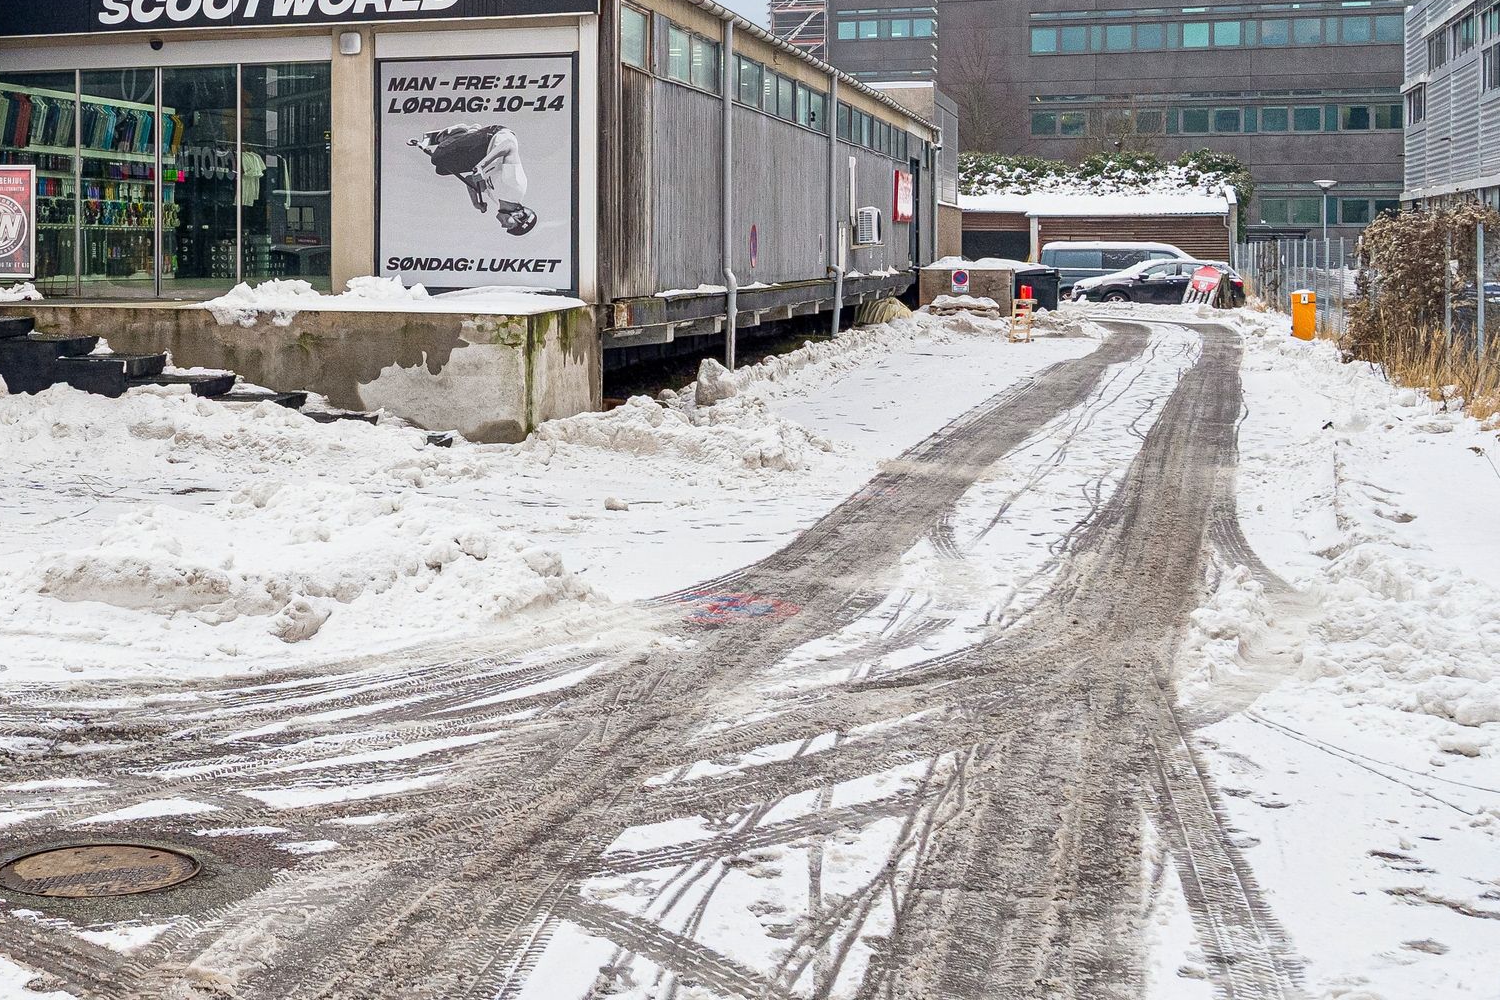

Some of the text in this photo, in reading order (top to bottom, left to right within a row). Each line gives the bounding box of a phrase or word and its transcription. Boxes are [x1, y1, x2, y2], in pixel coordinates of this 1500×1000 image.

[387, 76, 437, 92] MAN
[452, 75, 501, 91] FRE:
[502, 74, 566, 90] 11-17
[387, 95, 565, 114] LØRDAG: 10-14
[386, 256, 562, 273] SØNDAG: LUKKET
